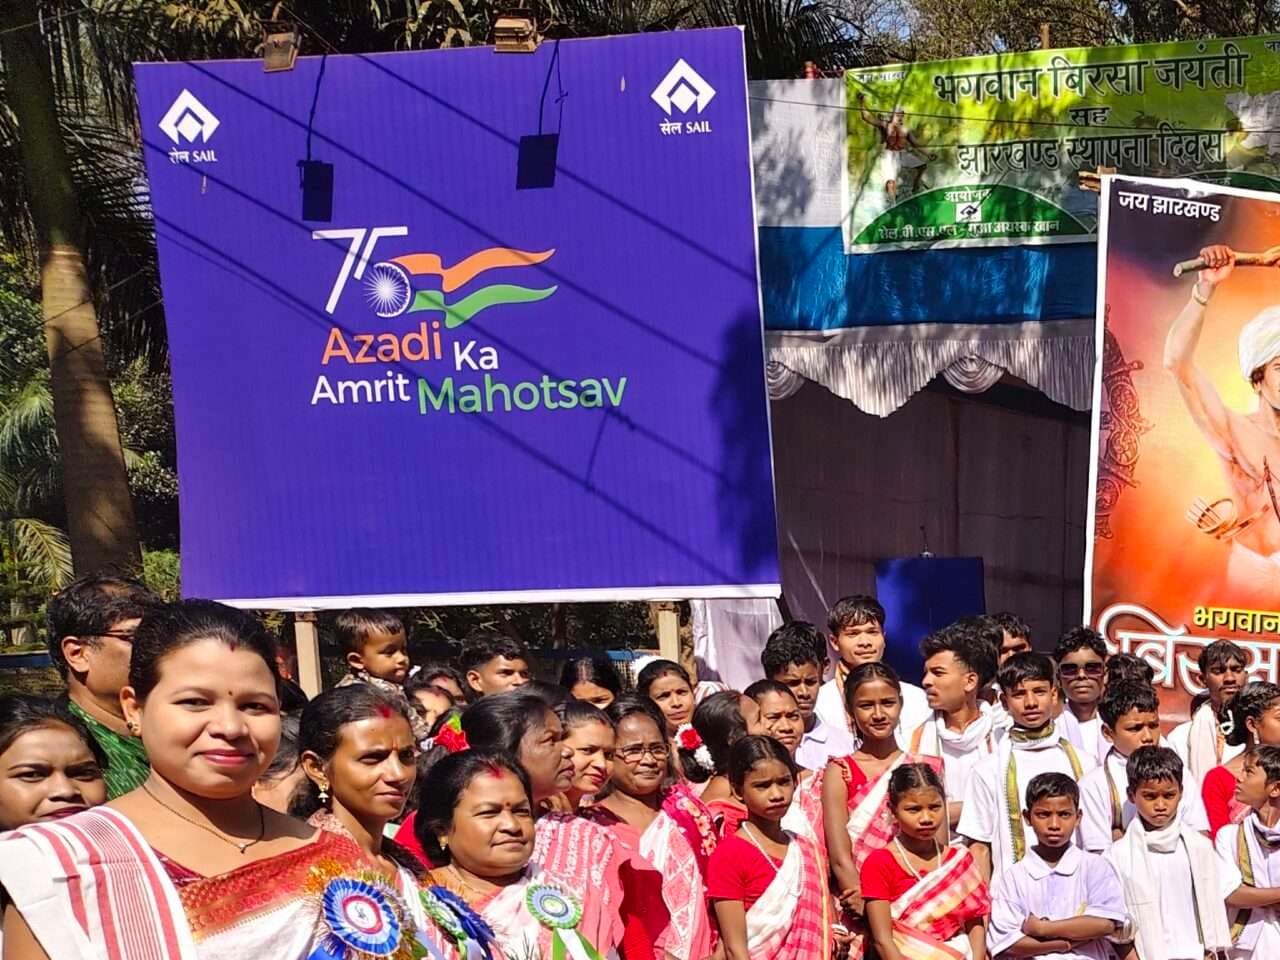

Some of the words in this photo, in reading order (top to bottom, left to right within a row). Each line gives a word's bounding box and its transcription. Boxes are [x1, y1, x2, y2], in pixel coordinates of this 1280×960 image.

[934, 68, 1043, 105] भगवान
[1048, 55, 1149, 97] बिरसा
[1154, 41, 1249, 91] जयंती
[658, 117, 683, 135] सेल
[686, 120, 712, 134] SAIL
[1069, 105, 1110, 127] सह
[192, 149, 218, 163] SAIL
[957, 138, 1061, 176] झारखण्ड
[1065, 131, 1155, 170] स्थापना
[1156, 121, 1226, 166] दिवस
[1118, 190, 1149, 211] जय
[1152, 195, 1221, 221] झारखण्ड
[321, 321, 443, 365] Azadi
[453, 340, 499, 371] Ka
[311, 371, 411, 405] Amrit
[417, 374, 627, 415] Mahotsav
